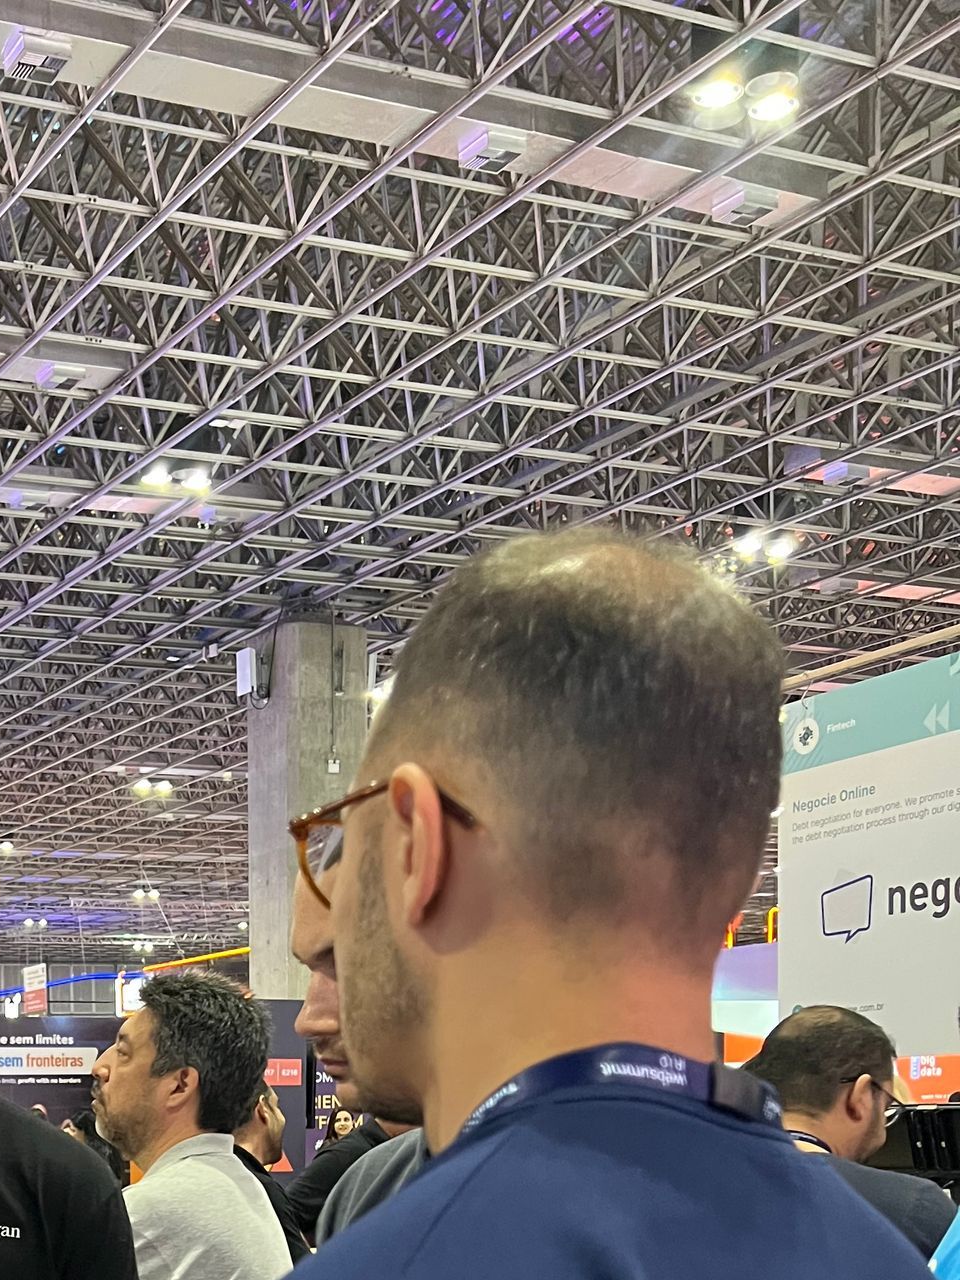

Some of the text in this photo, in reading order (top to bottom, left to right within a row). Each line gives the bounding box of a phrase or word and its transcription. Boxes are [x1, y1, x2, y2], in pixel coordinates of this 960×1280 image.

[792, 784, 876, 813] Negocie Online
[919, 788, 954, 806] promote
[932, 804, 945, 815] our
[10, 1035, 34, 1045] sem
[35, 1033, 74, 1045] limites
[26, 1052, 84, 1067] fronteiras
[600, 1061, 688, 1087] websummit
